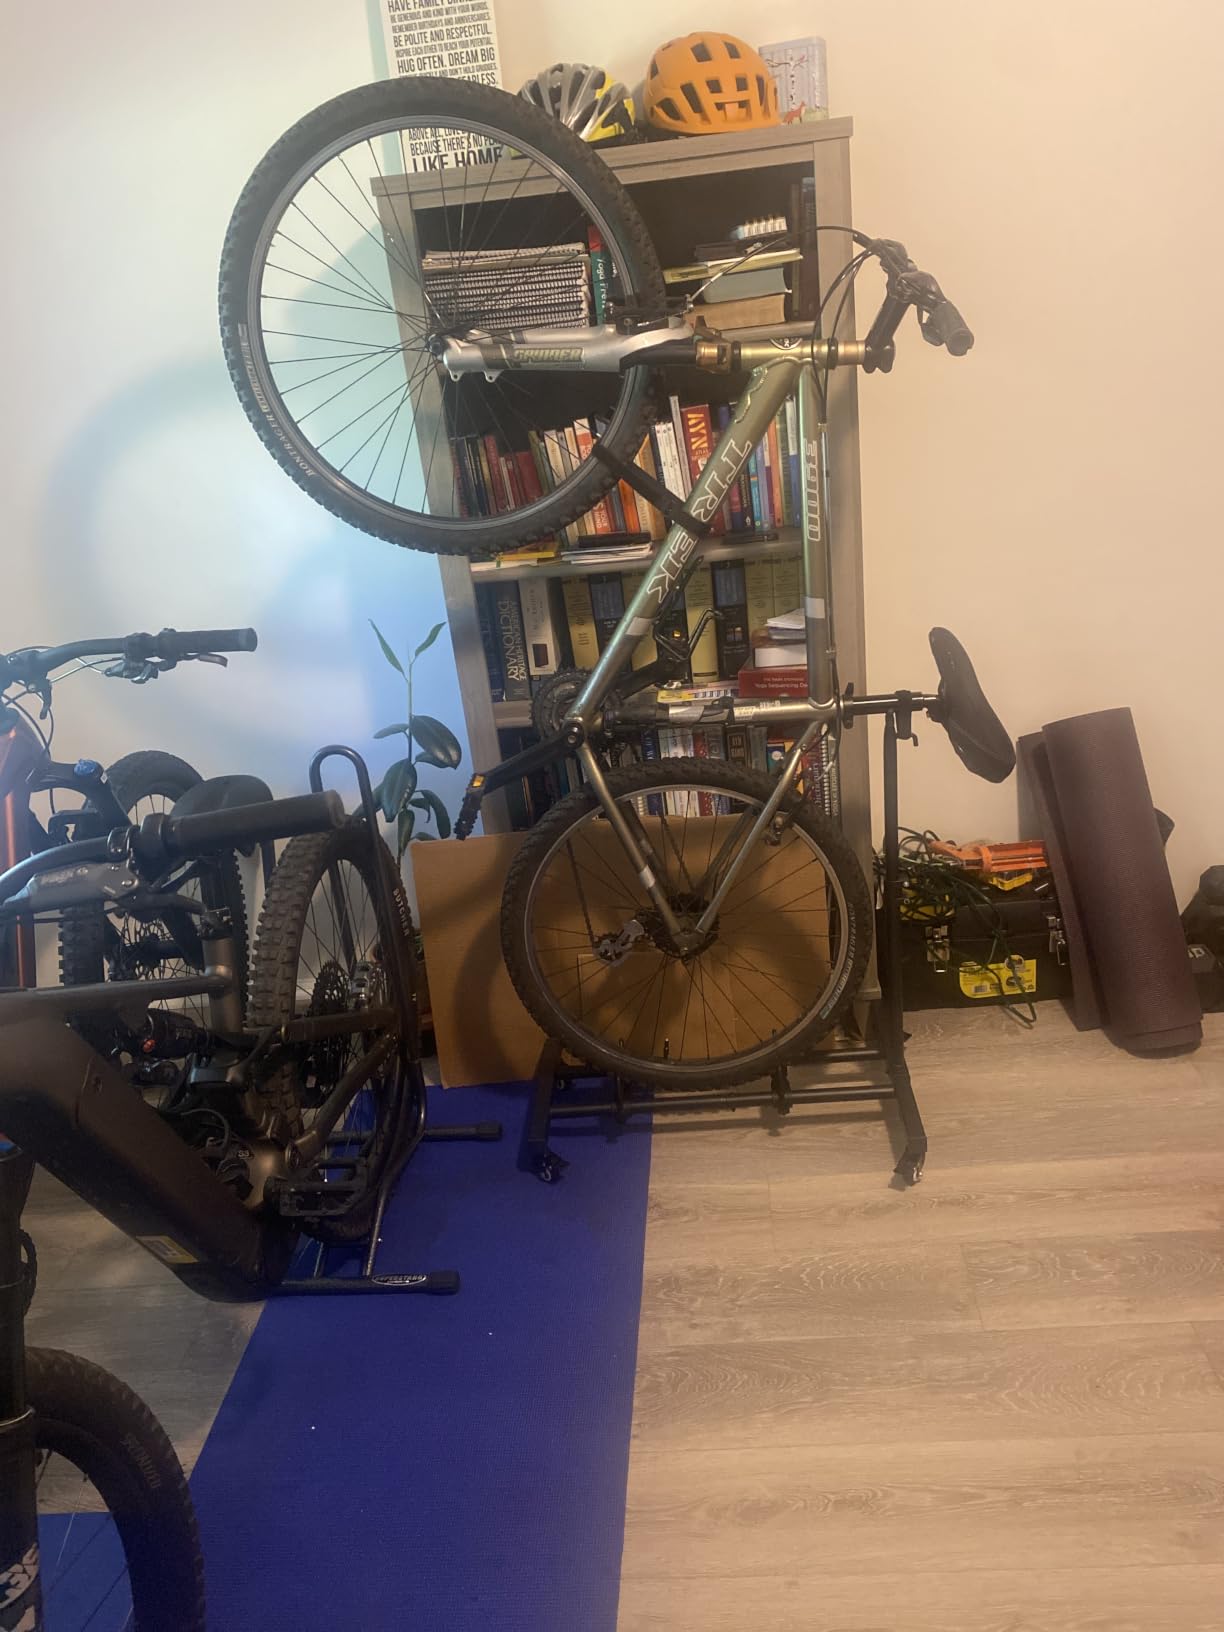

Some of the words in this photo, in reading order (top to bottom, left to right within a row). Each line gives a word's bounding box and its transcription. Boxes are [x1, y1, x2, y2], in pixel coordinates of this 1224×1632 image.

[388, 0, 411, 13] HAVE
[393, 35, 404, 48] BE
[404, 31, 428, 46] POLITE
[430, 29, 444, 42] AND
[446, 23, 492, 40] RESPECTFUL.
[397, 58, 416, 74] HUG
[416, 54, 447, 71] OFTEN.
[448, 49, 479, 67] DREAM
[480, 46, 495, 62] BIG
[458, 72, 499, 86] RLESS.
[408, 128, 430, 141] ABOVE
[410, 139, 441, 156] BECAUSE
[412, 154, 448, 172] LIKE
[454, 146, 502, 168] HOME
[265, 413, 315, 477] BONTRAGER
[687, 413, 709, 450] AYN
[803, 438, 821, 542] 3900
[646, 439, 753, 603] TREK
[498, 600, 520, 681] DICTIONARY
[392, 888, 411, 935] BUTCHER
